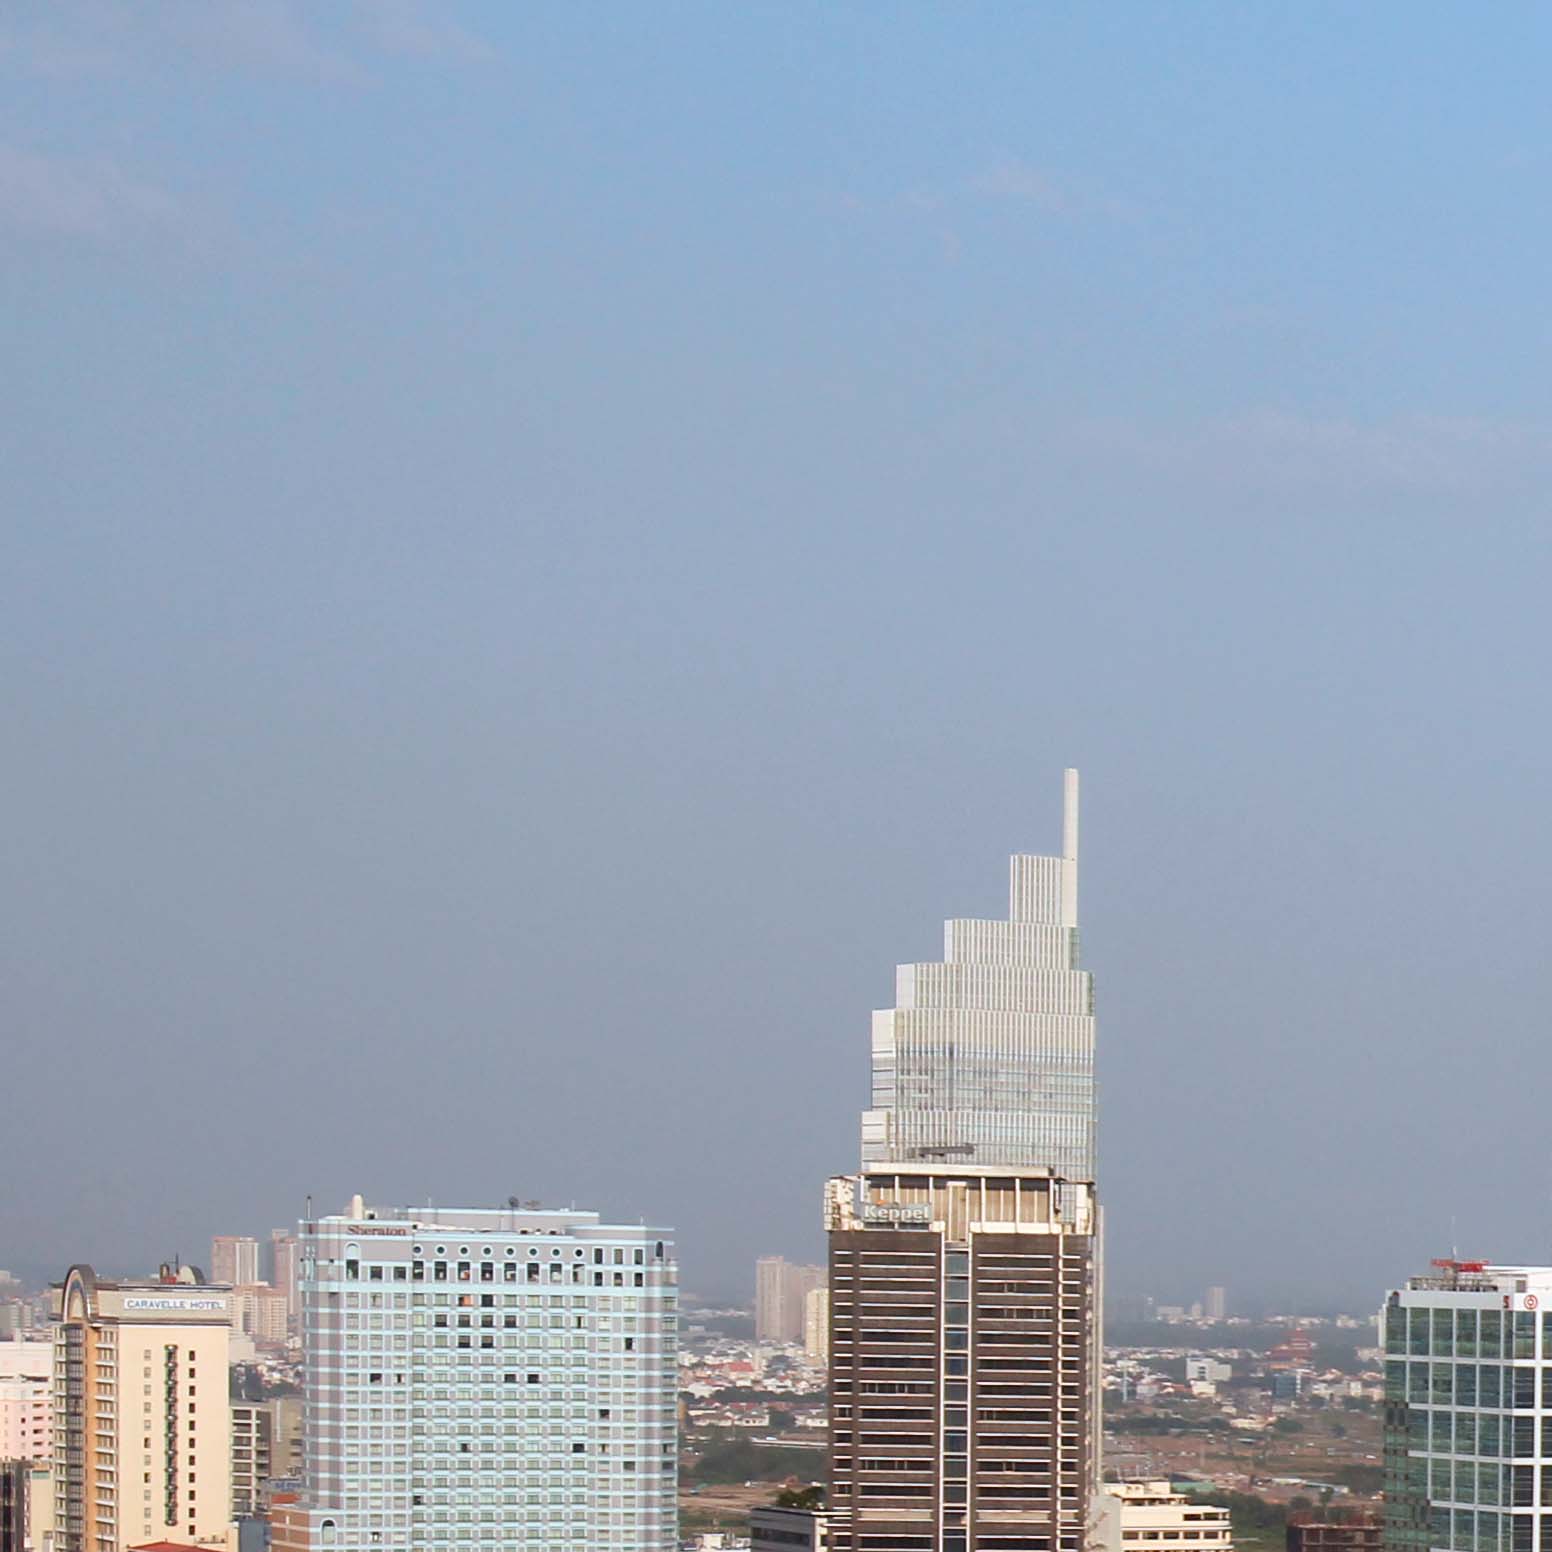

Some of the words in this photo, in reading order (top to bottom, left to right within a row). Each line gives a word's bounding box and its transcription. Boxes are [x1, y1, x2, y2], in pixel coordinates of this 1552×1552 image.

[864, 1205, 930, 1222] Keppel
[348, 1225, 407, 1236] Sheraton
[127, 1300, 186, 1309] CARAVELLE
[190, 1300, 224, 1309] HOTEL
